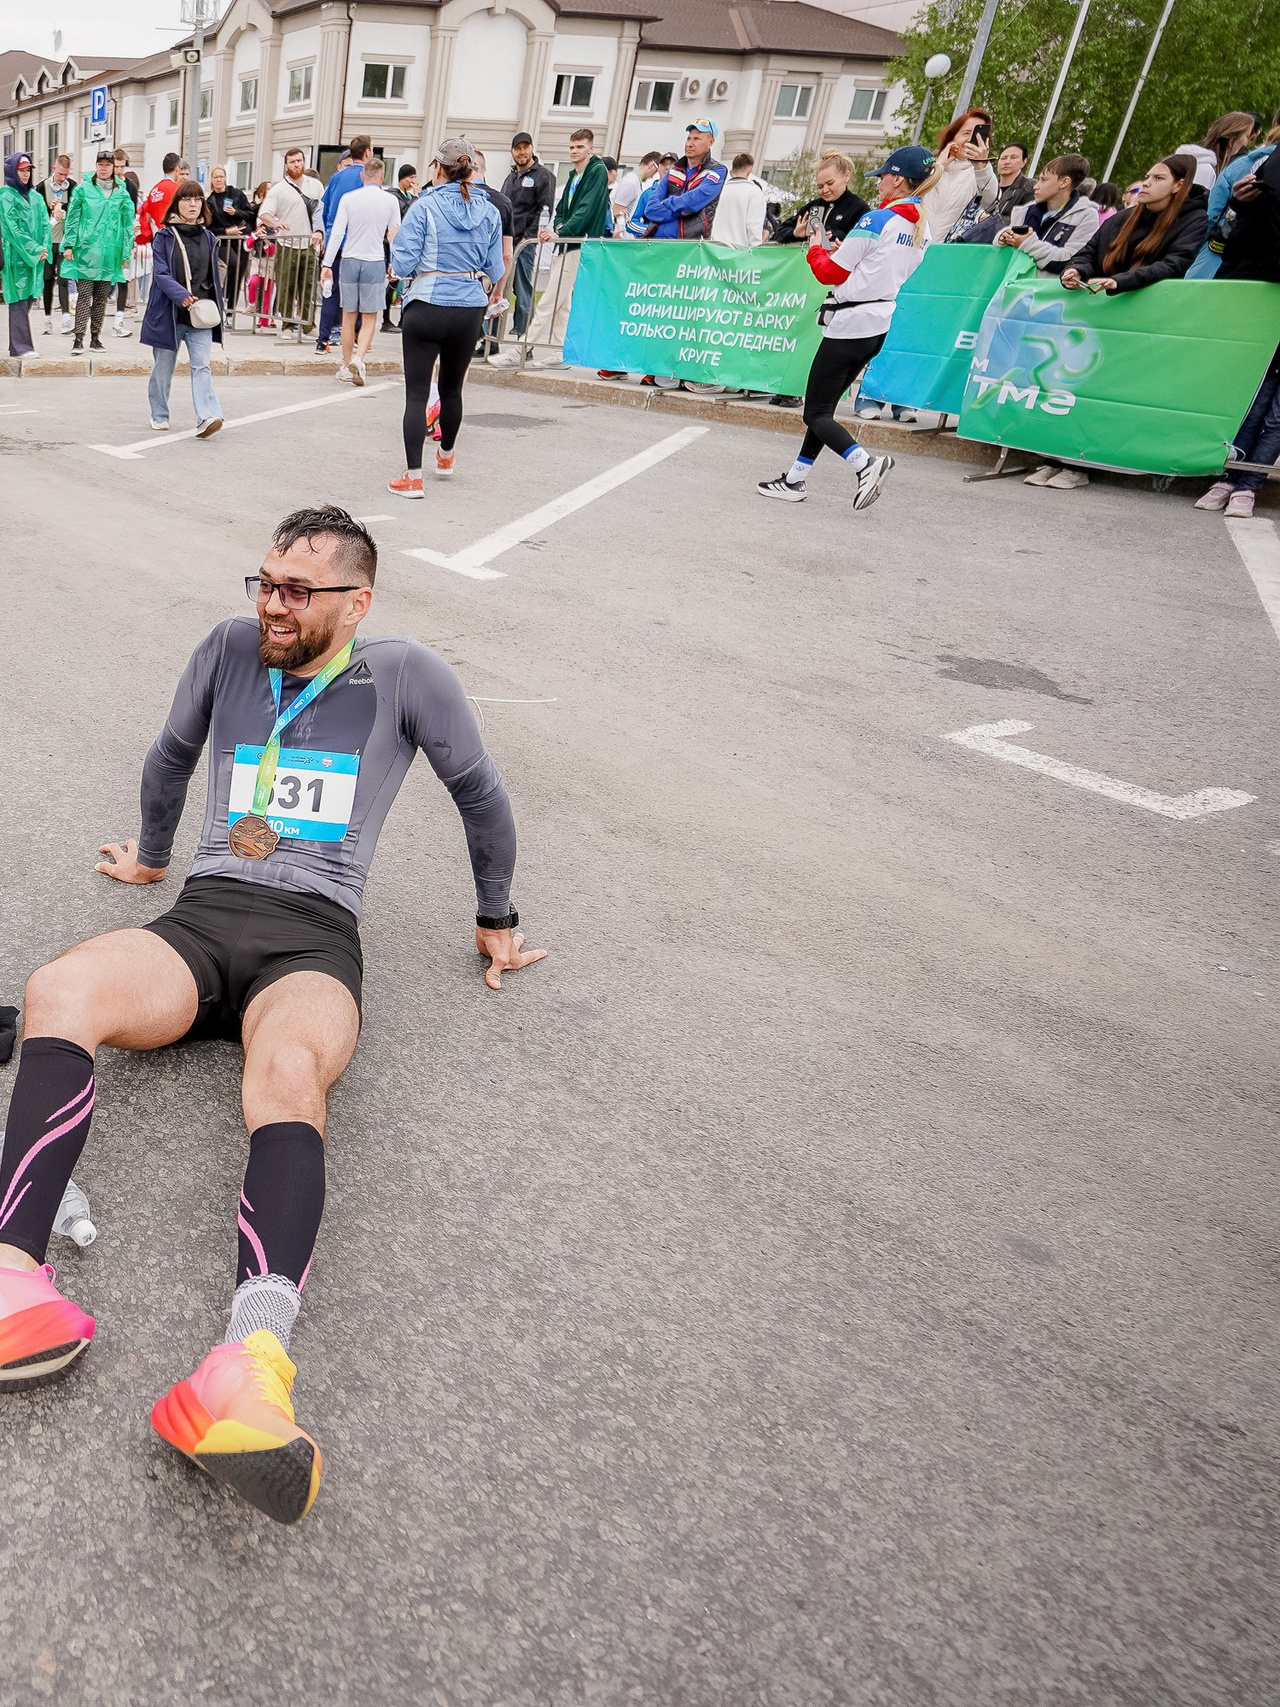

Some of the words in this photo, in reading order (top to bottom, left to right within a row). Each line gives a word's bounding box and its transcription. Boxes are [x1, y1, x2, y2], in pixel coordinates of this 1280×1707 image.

[94, 91, 105, 120] P
[677, 264, 761, 285] ВНИМАНИЕ
[625, 282, 719, 302] ДИСТАНЦИИ
[722, 288, 761, 309] 10КМ,
[765, 293, 782, 307] 21
[782, 293, 807, 308] КМ
[629, 302, 742, 324] ФИНИШИРУЮТ
[744, 313, 754, 327] В
[755, 314, 795, 330] АРКУ
[619, 321, 676, 340] ТОЛЬКО
[679, 327, 697, 342] НА
[698, 329, 797, 353] ПОСЛЕДНЕМ
[679, 347, 723, 367] КРУГЕ
[349, 677, 375, 686] Reebok
[267, 775, 324, 812] 31
